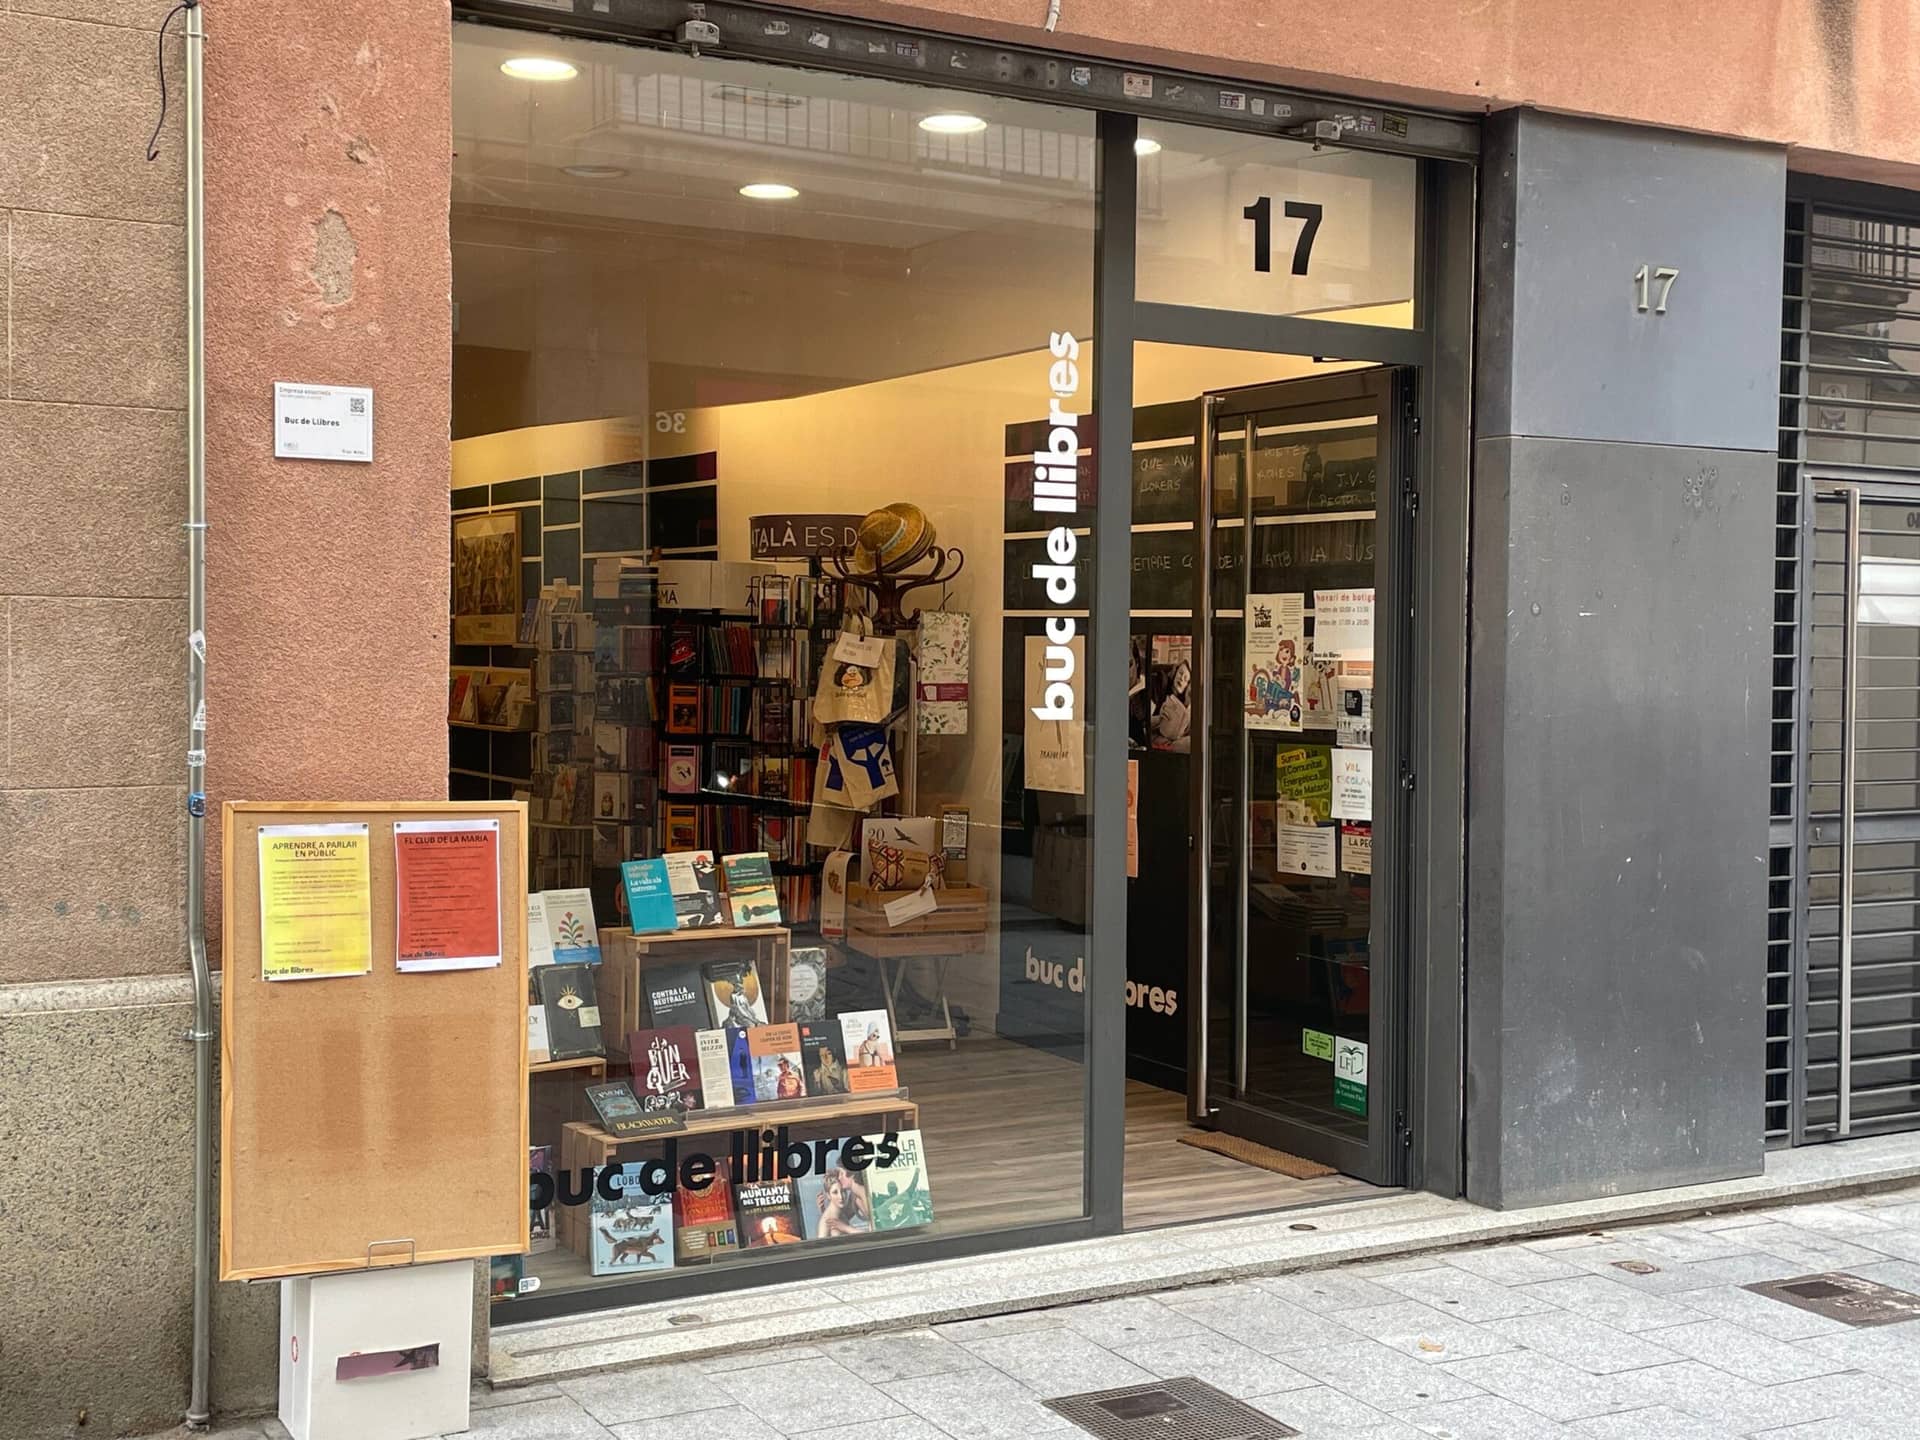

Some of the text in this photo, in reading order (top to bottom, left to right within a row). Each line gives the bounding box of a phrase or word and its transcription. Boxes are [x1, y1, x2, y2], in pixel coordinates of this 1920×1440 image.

[1243, 197, 1323, 276] 17
[1634, 264, 1680, 313] 17
[284, 416, 340, 427] Buc de Llibres
[1033, 331, 1080, 513] llibres
[805, 526, 836, 548] ES
[1032, 527, 1077, 604] de
[1031, 617, 1076, 721] buc
[272, 840, 358, 850] APRENDRE A PARLAR
[415, 835, 435, 844] CLUB
[437, 835, 448, 844] DE
[449, 834, 460, 843] LA
[461, 834, 489, 843] MARIA
[295, 849, 306, 858] EN
[264, 965, 314, 976] buc de llibres
[1025, 946, 1063, 989] buc
[652, 986, 688, 999] CONTRA LA
[653, 991, 696, 1006] NEUTRALITAT
[615, 1117, 678, 1131] BLACKWATER
[639, 1138, 716, 1197] de
[732, 1125, 900, 1185] llibres
[740, 1184, 790, 1201] MUNTANYA
[743, 1195, 790, 1207] DEL TRESOR
